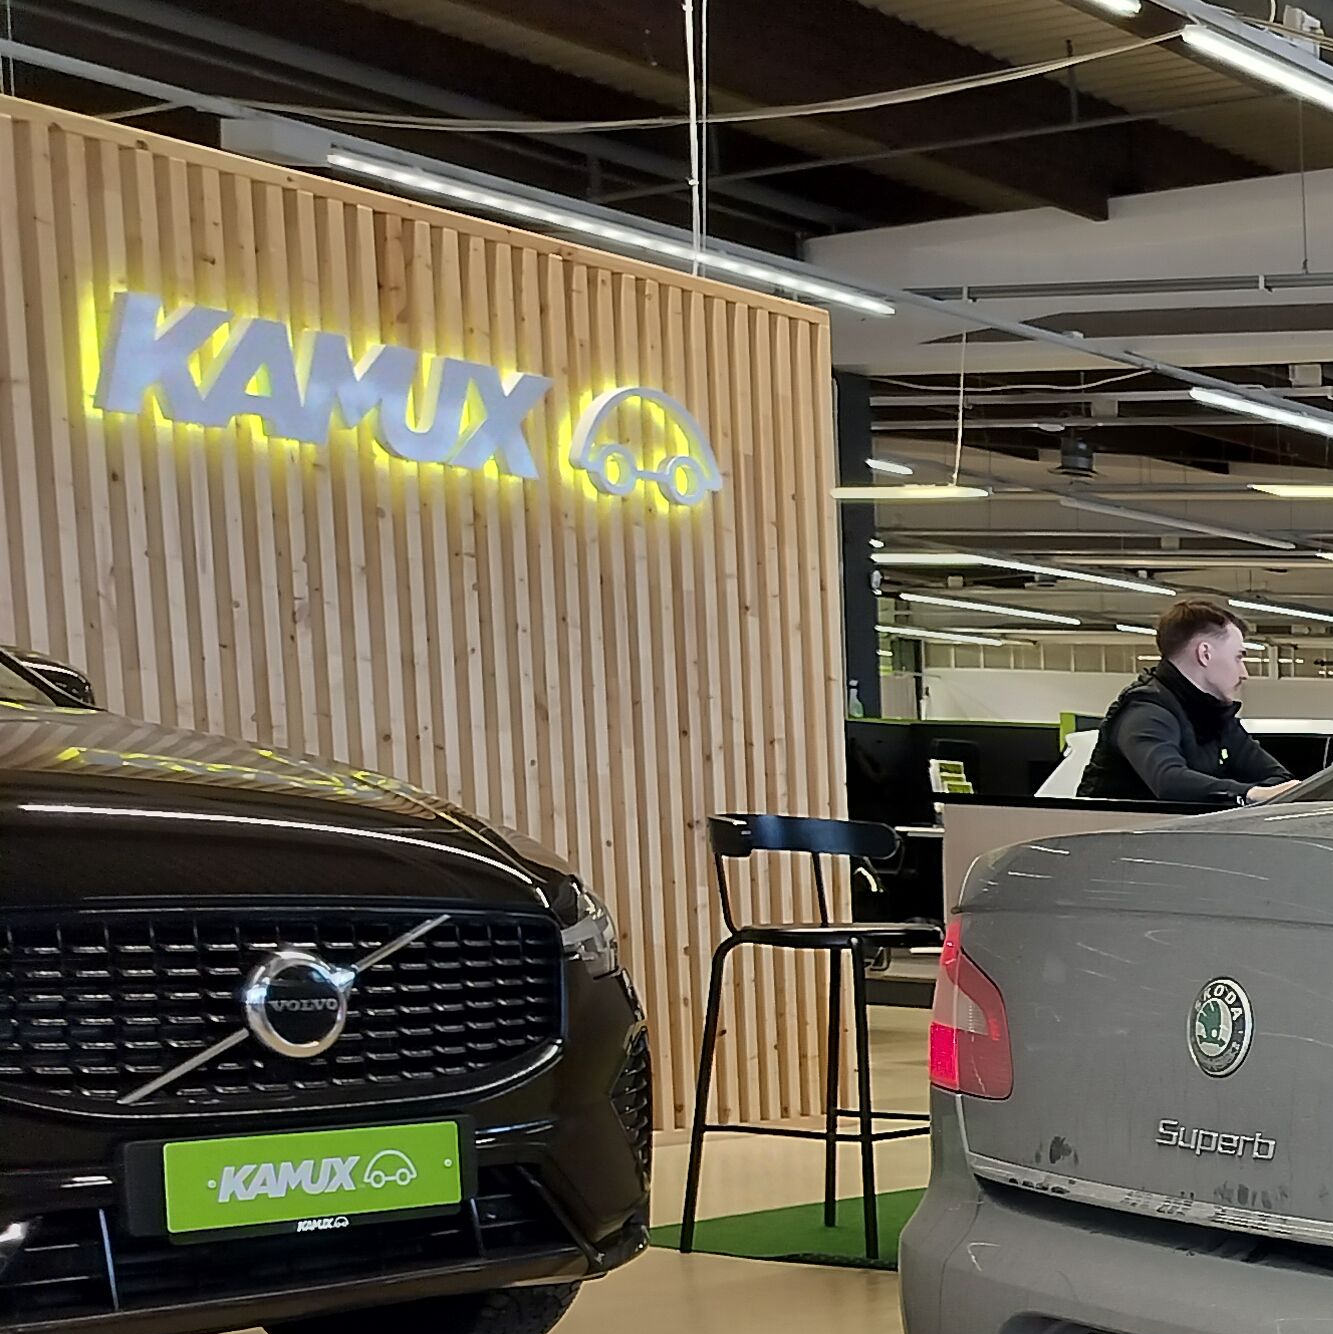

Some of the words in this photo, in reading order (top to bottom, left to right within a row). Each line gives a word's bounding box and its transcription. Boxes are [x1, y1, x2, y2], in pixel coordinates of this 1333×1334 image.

[93, 291, 553, 480] KAMUX
[267, 998, 338, 1012] VOLVO
[1154, 1118, 1276, 1160] Superb
[217, 1155, 361, 1203] KAMUX
[296, 1217, 334, 1233] KAMUX
